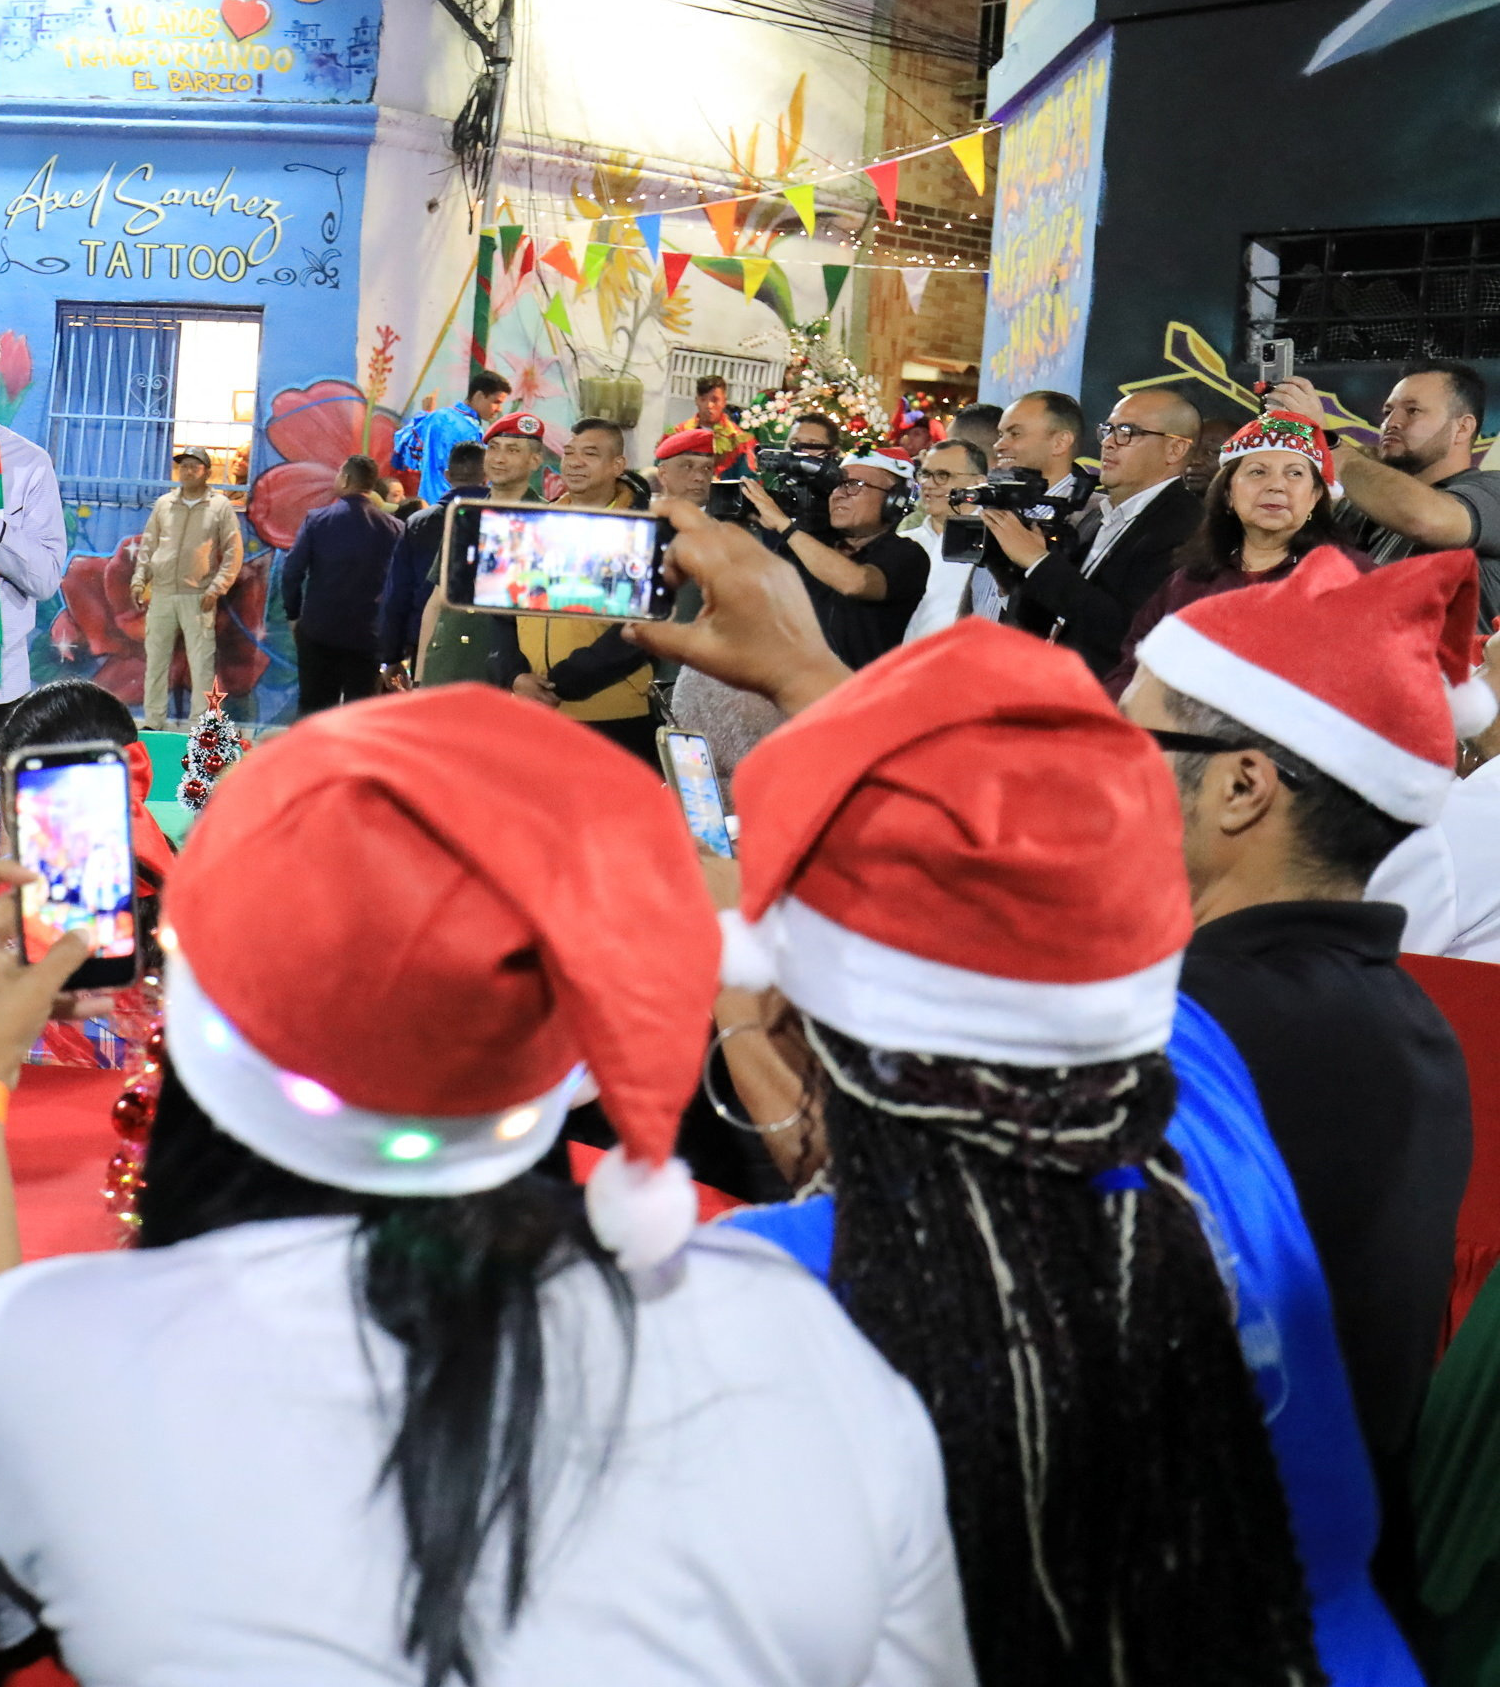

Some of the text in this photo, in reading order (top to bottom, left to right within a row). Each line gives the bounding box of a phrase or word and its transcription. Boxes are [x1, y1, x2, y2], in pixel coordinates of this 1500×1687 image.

[54, 36, 294, 73] TRANSFORMANDO
[132, 71, 158, 90] EL
[4, 153, 295, 267] Axel Sanchez
[79, 239, 247, 283] TATTOO
